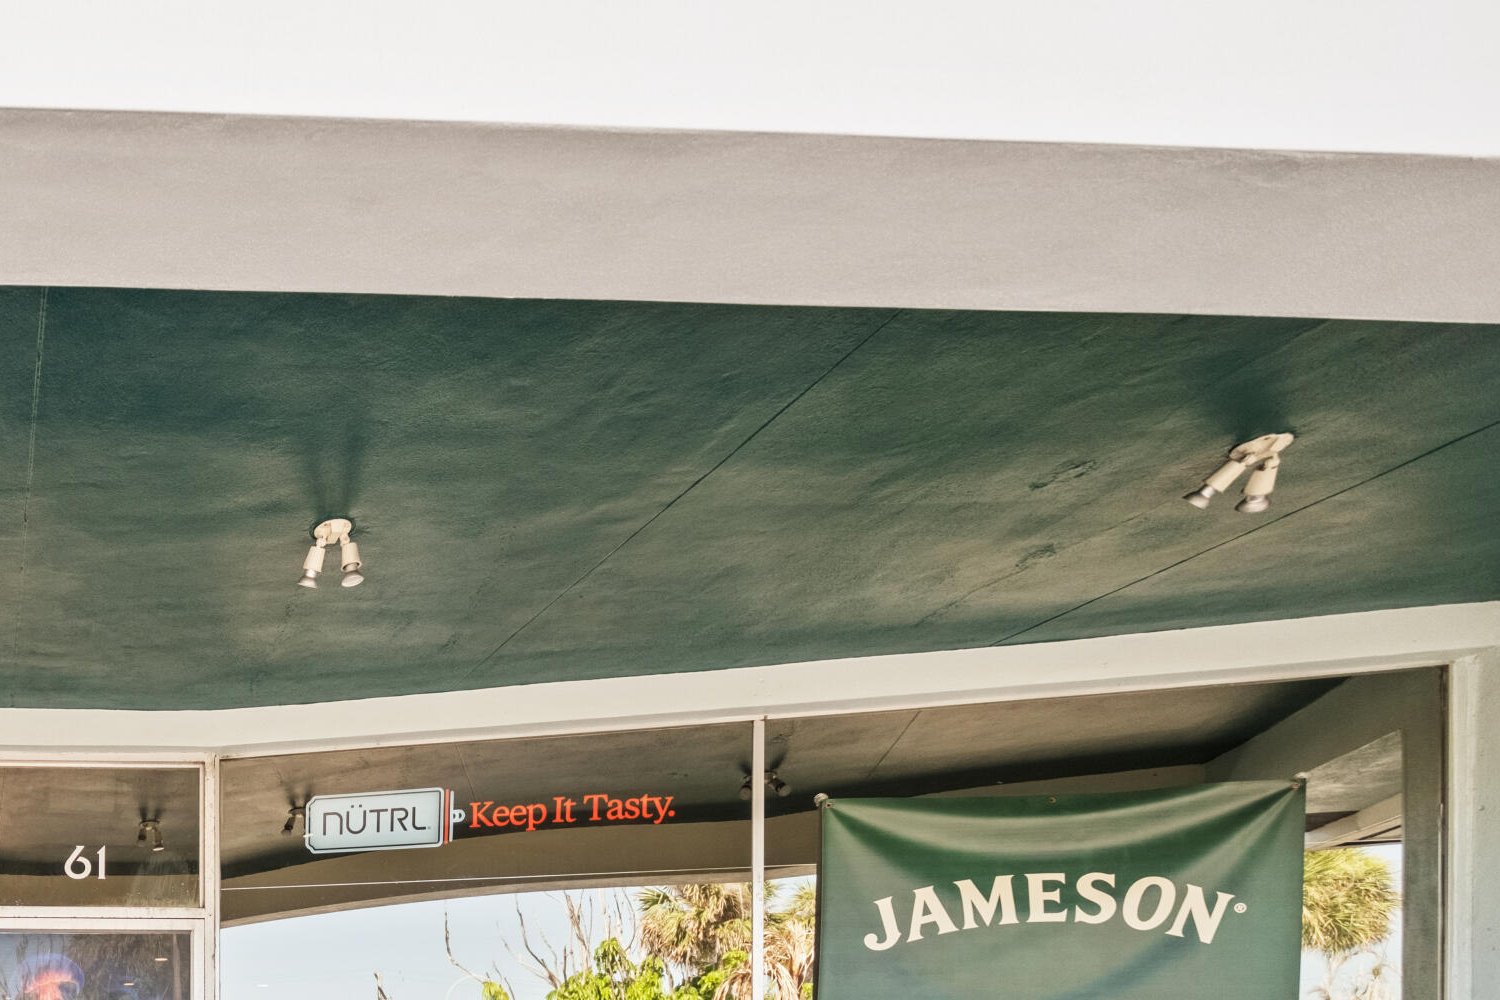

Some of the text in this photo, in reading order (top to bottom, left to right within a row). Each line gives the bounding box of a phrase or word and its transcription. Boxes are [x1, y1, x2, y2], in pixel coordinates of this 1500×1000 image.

[470, 794, 675, 831] Keep It Tasty.
[64, 845, 106, 880] 61
[863, 872, 1236, 951] JAMESON
